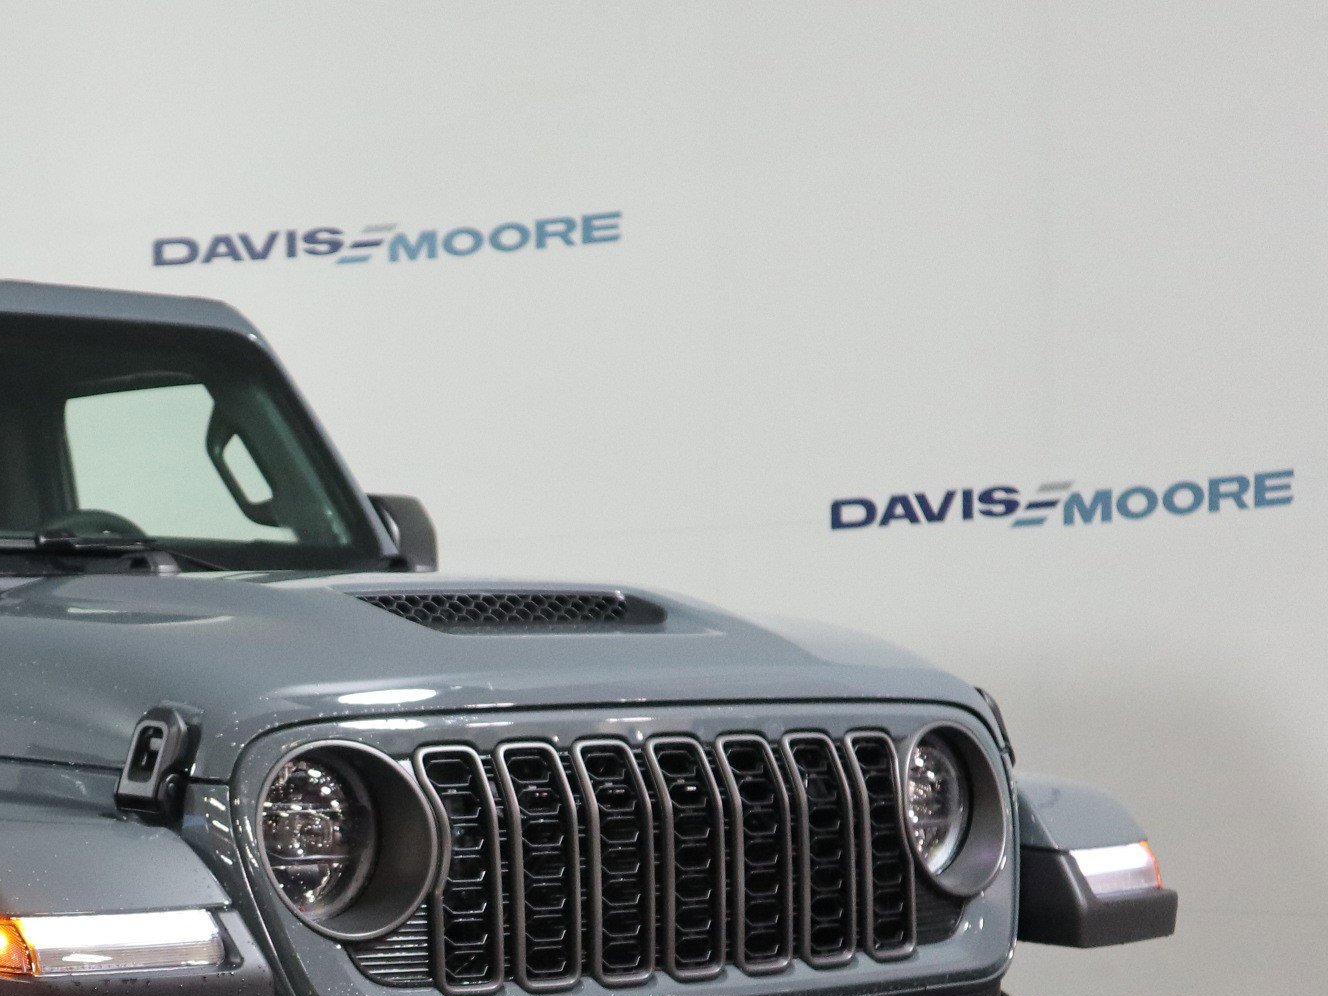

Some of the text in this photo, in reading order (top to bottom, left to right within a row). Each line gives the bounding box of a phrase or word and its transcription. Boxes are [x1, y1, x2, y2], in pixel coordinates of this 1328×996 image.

[152, 211, 622, 267] DAVIS MOORE
[830, 469, 1295, 530] DAVIS MOORE
